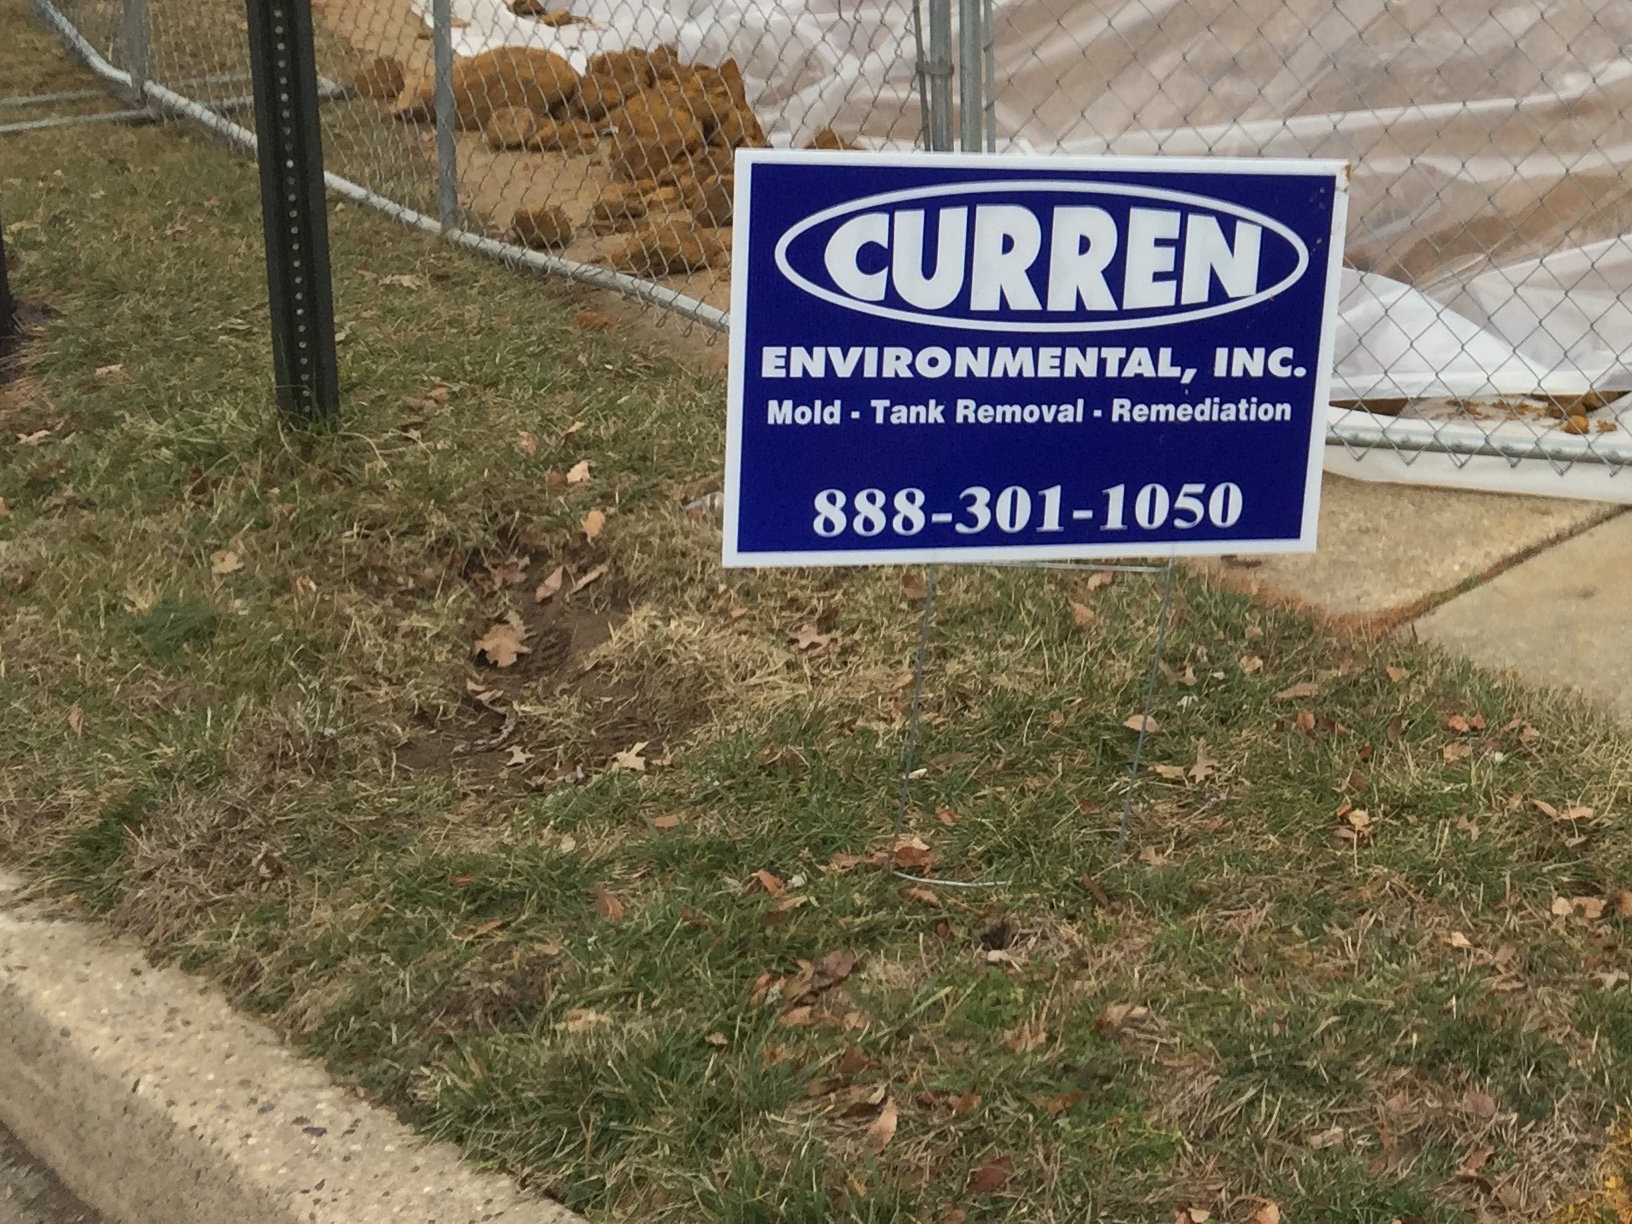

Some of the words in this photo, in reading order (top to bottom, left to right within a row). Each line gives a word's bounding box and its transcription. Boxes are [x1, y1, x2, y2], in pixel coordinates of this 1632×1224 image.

[823, 204, 1262, 312] CURREN
[761, 346, 1198, 385] ENVIRONMENTAL,
[1213, 347, 1307, 378] INC.
[767, 399, 841, 425] Mold
[870, 399, 945, 424] Tank
[955, 398, 1084, 424] Removal
[1111, 397, 1292, 422] Remediation
[813, 482, 1244, 537] 888-301-1050
